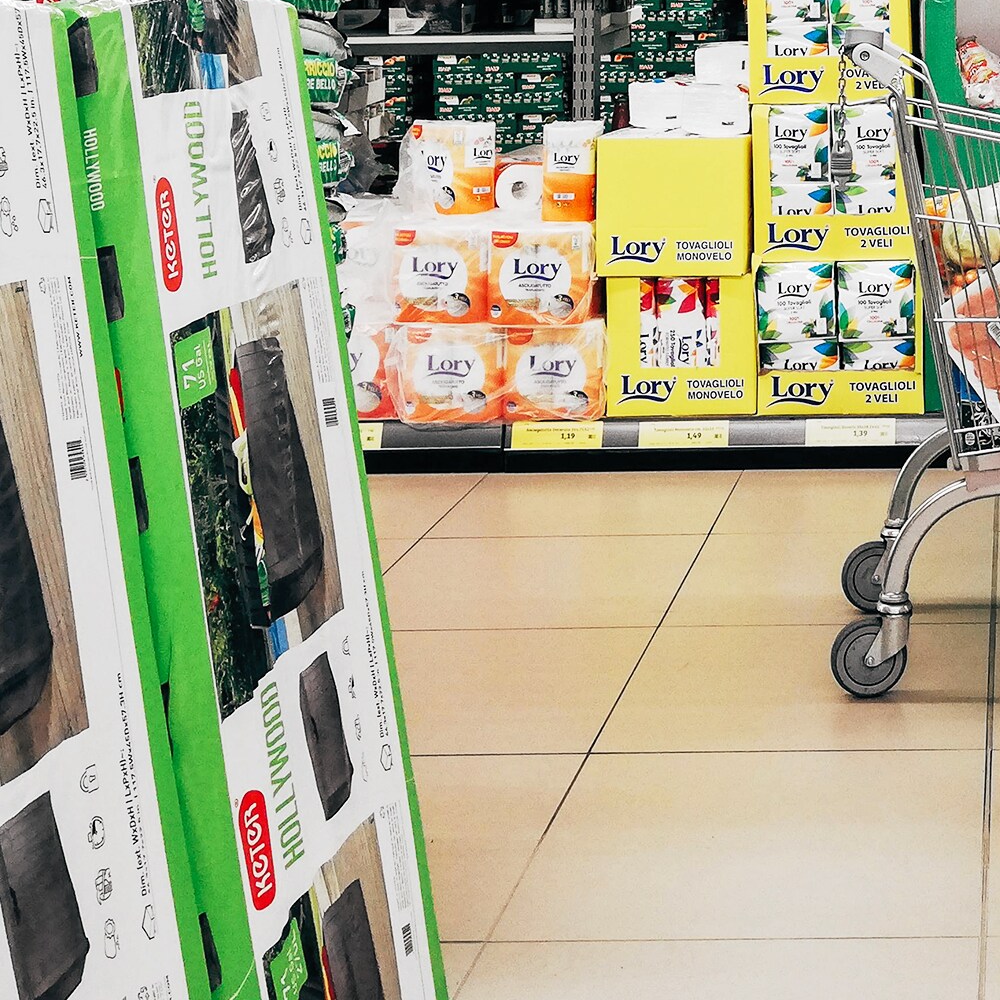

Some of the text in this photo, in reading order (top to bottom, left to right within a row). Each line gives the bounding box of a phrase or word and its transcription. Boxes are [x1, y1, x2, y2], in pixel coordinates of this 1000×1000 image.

[763, 65, 824, 92] Lory
[856, 82, 862, 90] 2
[775, 126, 808, 142] Lory
[857, 126, 891, 143] Lory
[553, 152, 580, 165] Lory
[82, 127, 106, 212] HOLLYWOOD
[184, 101, 220, 280] HOLLYWOOD
[768, 223, 829, 251] Lory
[844, 226, 910, 236] TOVAGLIOLI
[611, 236, 666, 262] Lory
[676, 241, 732, 250] TOVAGLIOLI
[860, 238, 892, 248] 2 VELI
[676, 252, 732, 260] MONOVELO
[412, 257, 459, 280] Lory
[514, 258, 562, 281] Lory
[778, 282, 812, 299] Lory
[858, 282, 892, 298] Lory
[679, 336, 692, 365] Lory
[182, 359, 198, 390] 71
[194, 344, 206, 390] US Gal
[428, 355, 476, 377] Lory
[530, 355, 576, 377] Lory
[621, 376, 676, 402] Lory
[687, 379, 744, 388] TOVAGLIOLI
[771, 376, 834, 406] Lory
[849, 381, 916, 391] TOVAGLIOLI
[688, 390, 744, 400] MONOVELO
[866, 394, 898, 404] 2 VELI
[561, 432, 576, 440] 1,19
[686, 432, 702, 440] 1,49
[260, 682, 305, 870] HOLLYWOOD
[127, 806, 139, 844] WxDxH
